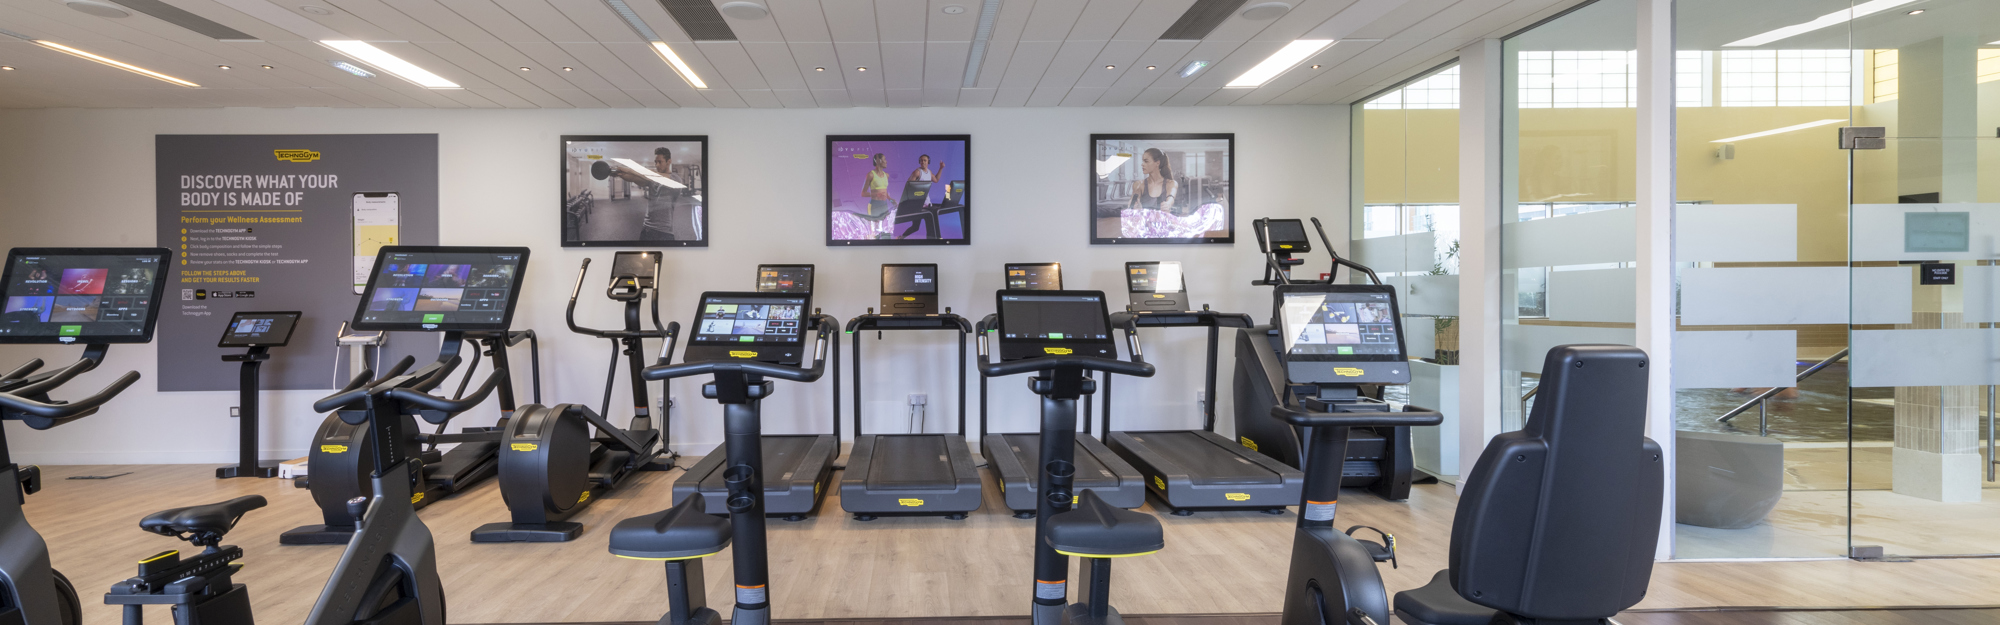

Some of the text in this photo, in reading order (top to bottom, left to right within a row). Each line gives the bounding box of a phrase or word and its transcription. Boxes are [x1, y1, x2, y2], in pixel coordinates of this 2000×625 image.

[275, 150, 320, 161] TECHNOGYM
[181, 174, 338, 188] DISCOVER WHAT YOUR
[181, 192, 304, 206] BODY IS MADE OF
